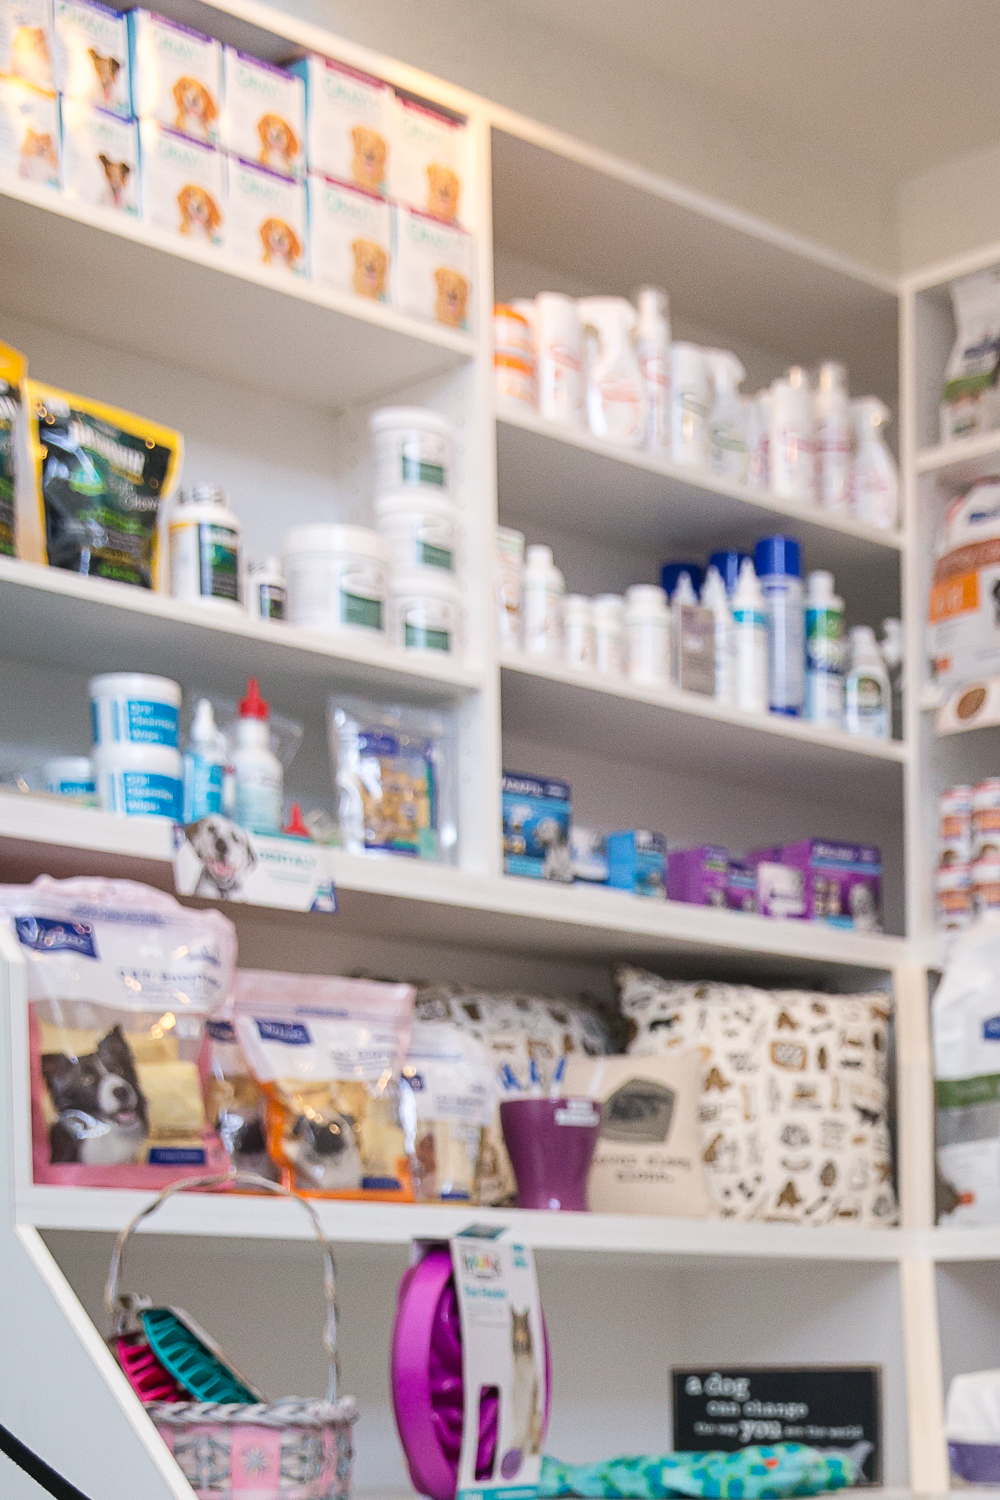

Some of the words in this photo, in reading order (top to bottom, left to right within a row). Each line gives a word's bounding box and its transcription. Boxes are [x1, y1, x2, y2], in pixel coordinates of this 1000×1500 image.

[685, 1376, 701, 1396] a
[704, 1372, 750, 1400] dog
[738, 1419, 783, 1443] you
